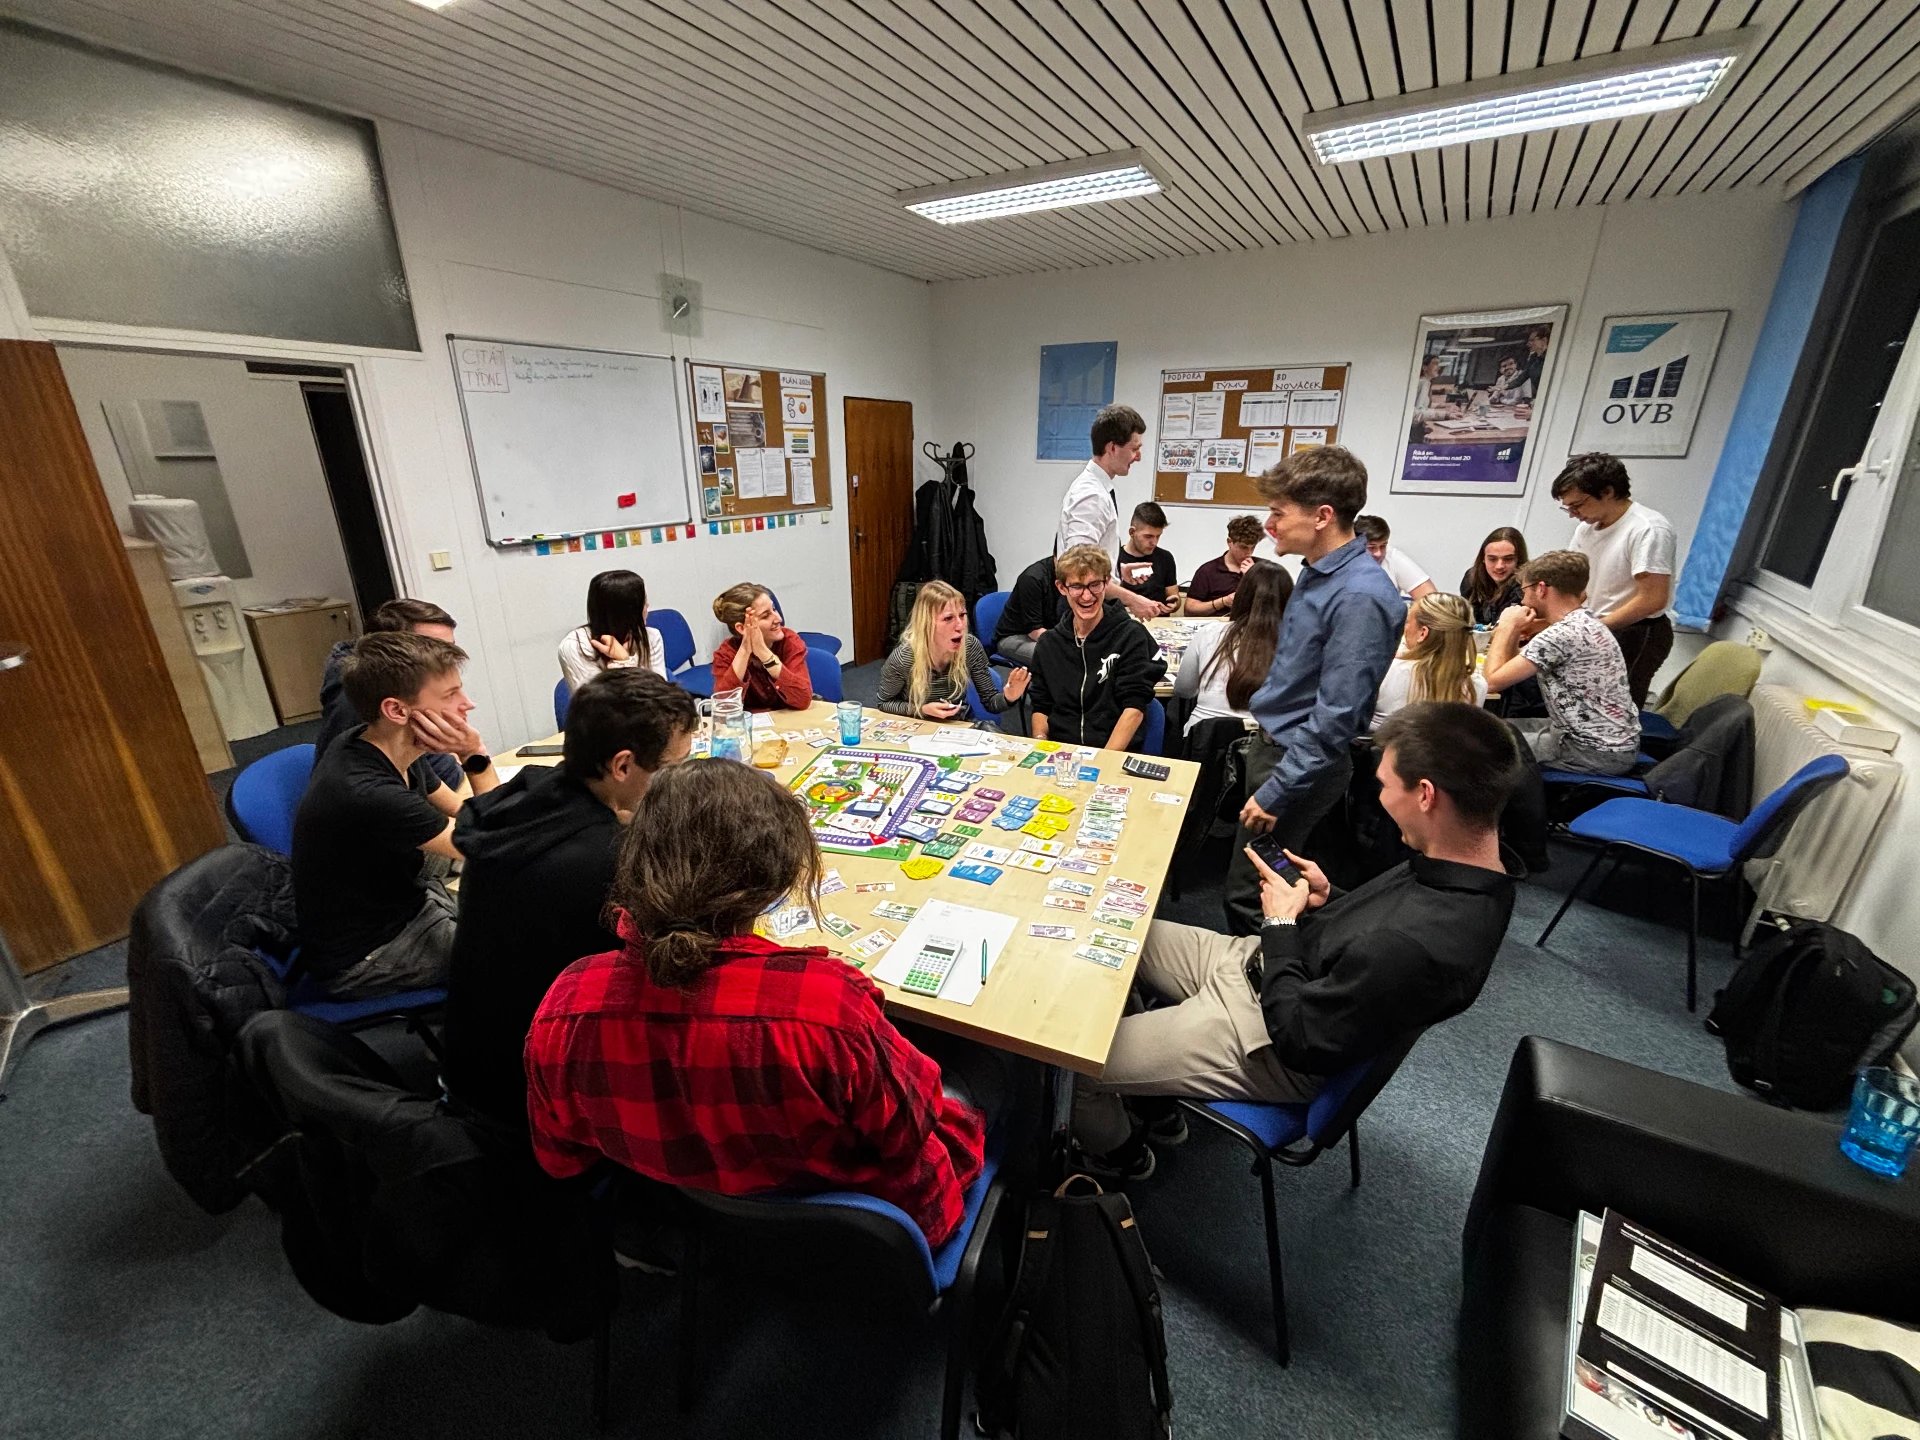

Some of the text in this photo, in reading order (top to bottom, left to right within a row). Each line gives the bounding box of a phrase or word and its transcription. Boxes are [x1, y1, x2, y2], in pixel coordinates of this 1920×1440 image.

[1167, 373, 1202, 381] PODPORA
[1275, 380, 1321, 391] NOVÁČEK
[1602, 403, 1674, 425] OVB
